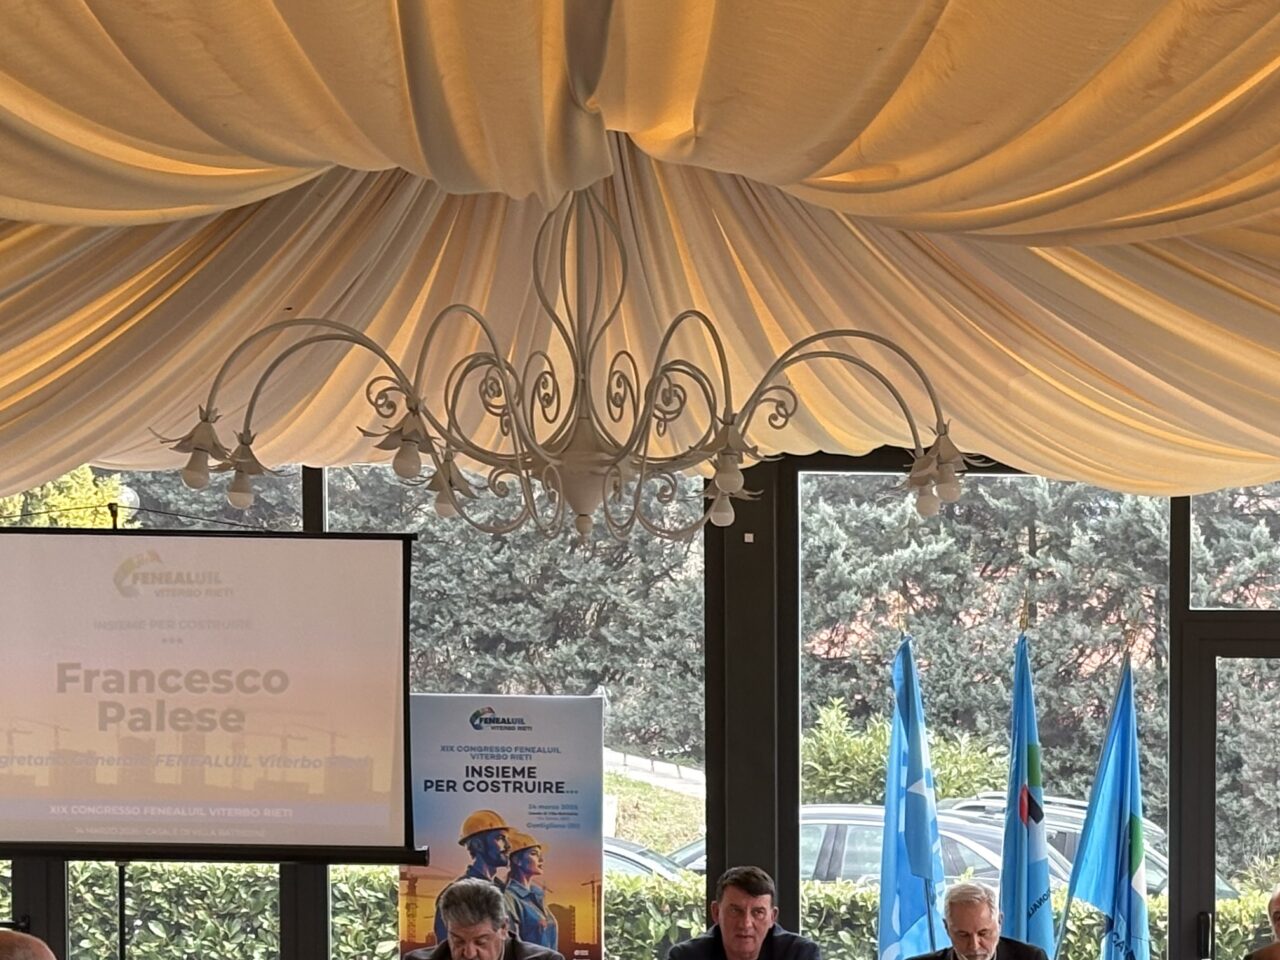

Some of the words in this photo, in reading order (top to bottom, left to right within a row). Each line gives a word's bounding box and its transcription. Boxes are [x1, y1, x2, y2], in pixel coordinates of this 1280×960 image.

[131, 571, 223, 585] FENEALUIL
[56, 662, 289, 695] Francesco
[98, 700, 246, 733] Palese
[480, 717, 526, 725] FENEALUIL
[440, 745, 455, 753] XIX
[456, 745, 513, 753] CONGRESSO
[514, 746, 561, 754] FENEALUIL
[155, 754, 252, 769] FENEALUIL
[258, 755, 322, 769] Viterbo
[470, 753, 508, 761] VITERBO
[465, 765, 537, 778] INSIEME
[423, 780, 457, 792] PER
[50, 805, 68, 815] XIX
[71, 805, 140, 816] CONGRESSO
[143, 805, 207, 817] FENEALUIL
[208, 807, 260, 818] VITERBO
[263, 808, 293, 818] RIETI
